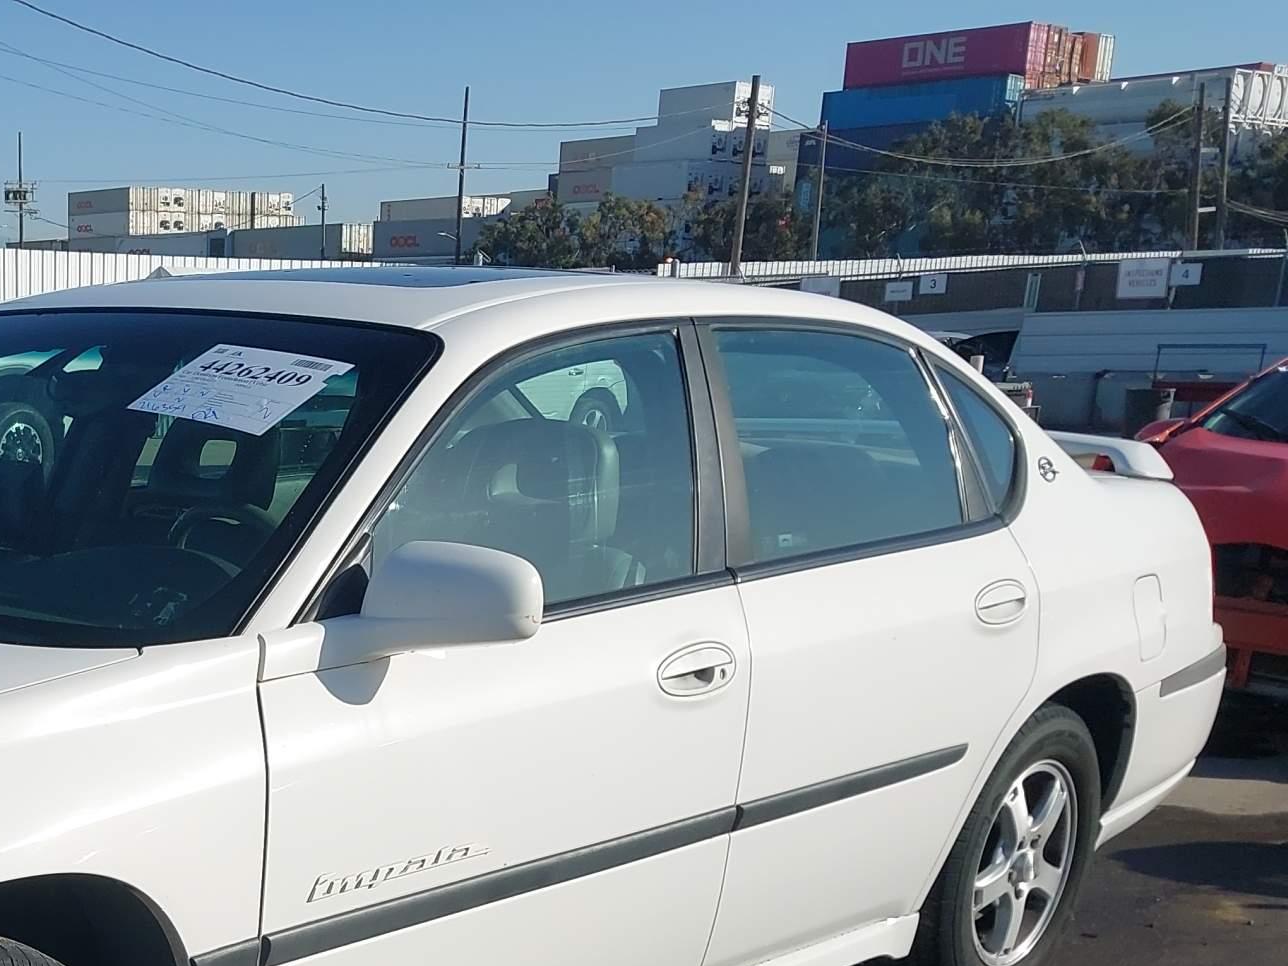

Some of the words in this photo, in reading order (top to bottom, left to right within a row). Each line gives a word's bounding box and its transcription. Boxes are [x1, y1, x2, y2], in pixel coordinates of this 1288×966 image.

[902, 36, 967, 68] ONE
[390, 234, 419, 248] OOCL
[1181, 269, 1189, 279] 4
[929, 279, 937, 289] 3
[200, 359, 313, 386] 44262409
